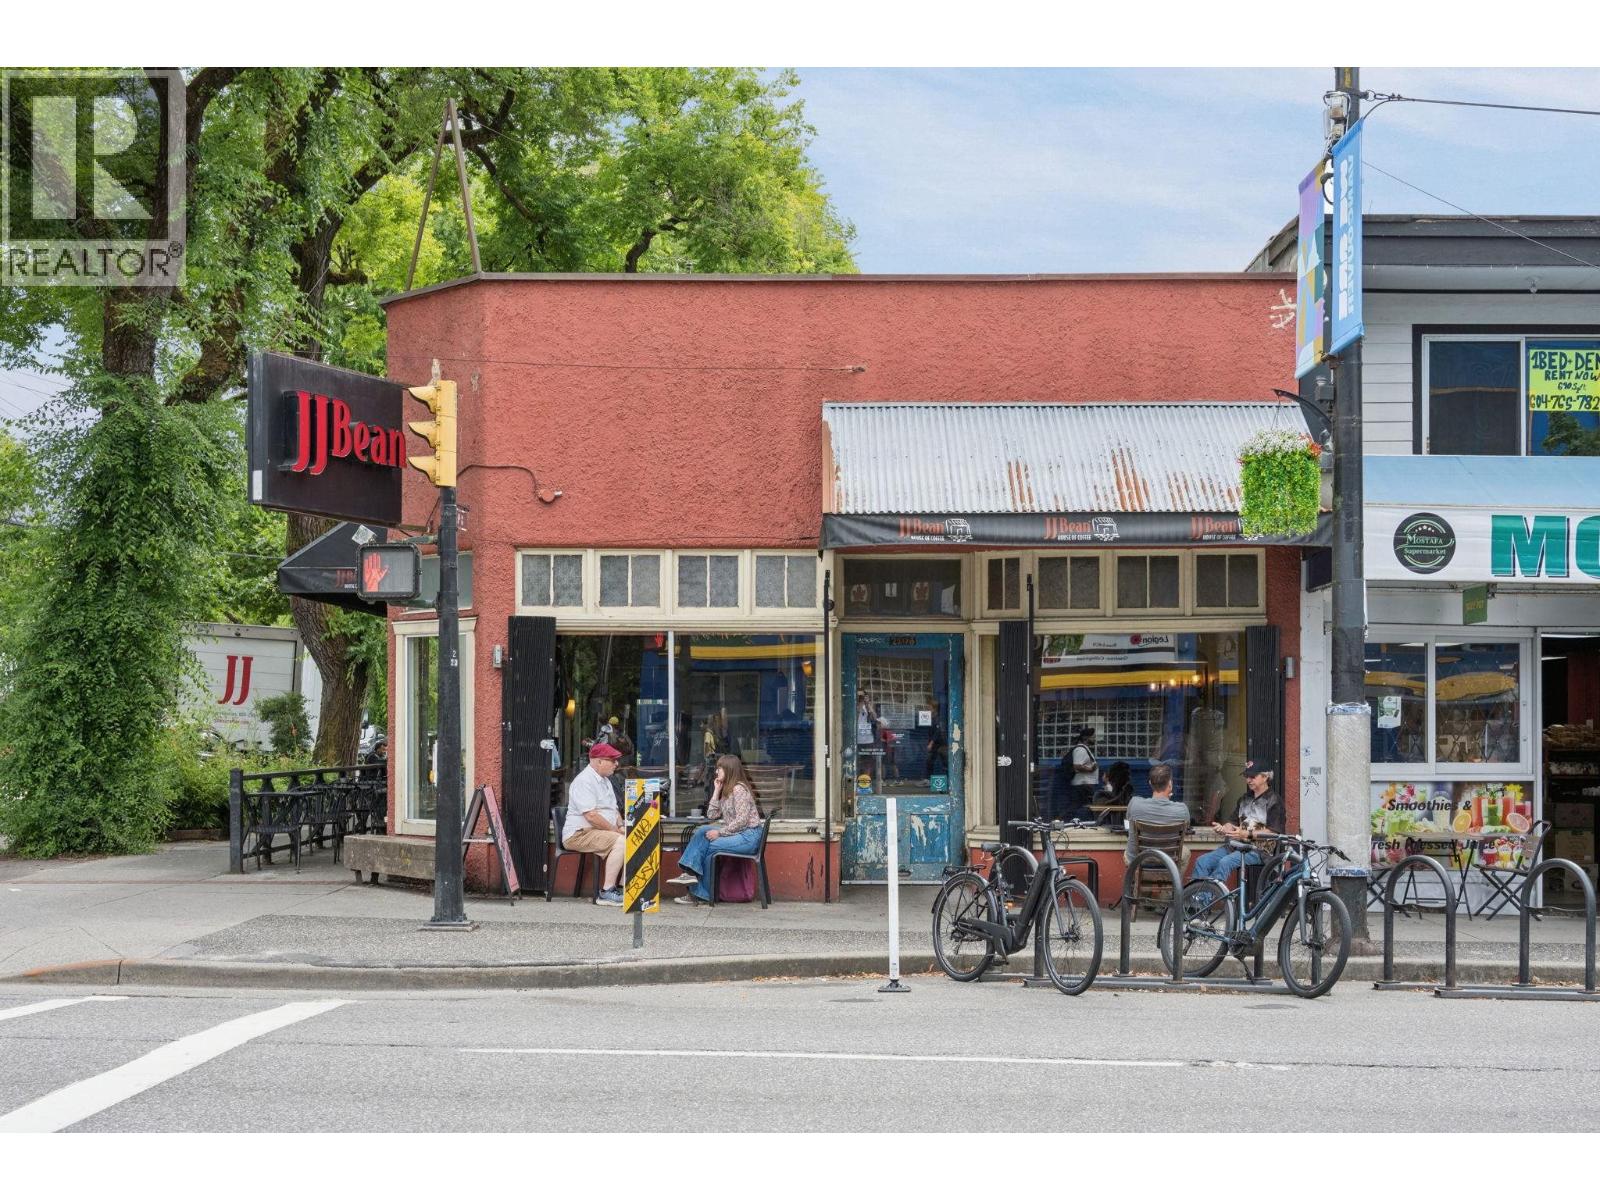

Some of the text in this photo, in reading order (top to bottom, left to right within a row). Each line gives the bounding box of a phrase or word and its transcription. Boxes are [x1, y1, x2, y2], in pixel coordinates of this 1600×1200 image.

[1544, 370, 1573, 381] RENT
[217, 655, 254, 706] JJ
[1388, 799, 1472, 811] Smoothies &
[1371, 838, 1400, 850] resh
